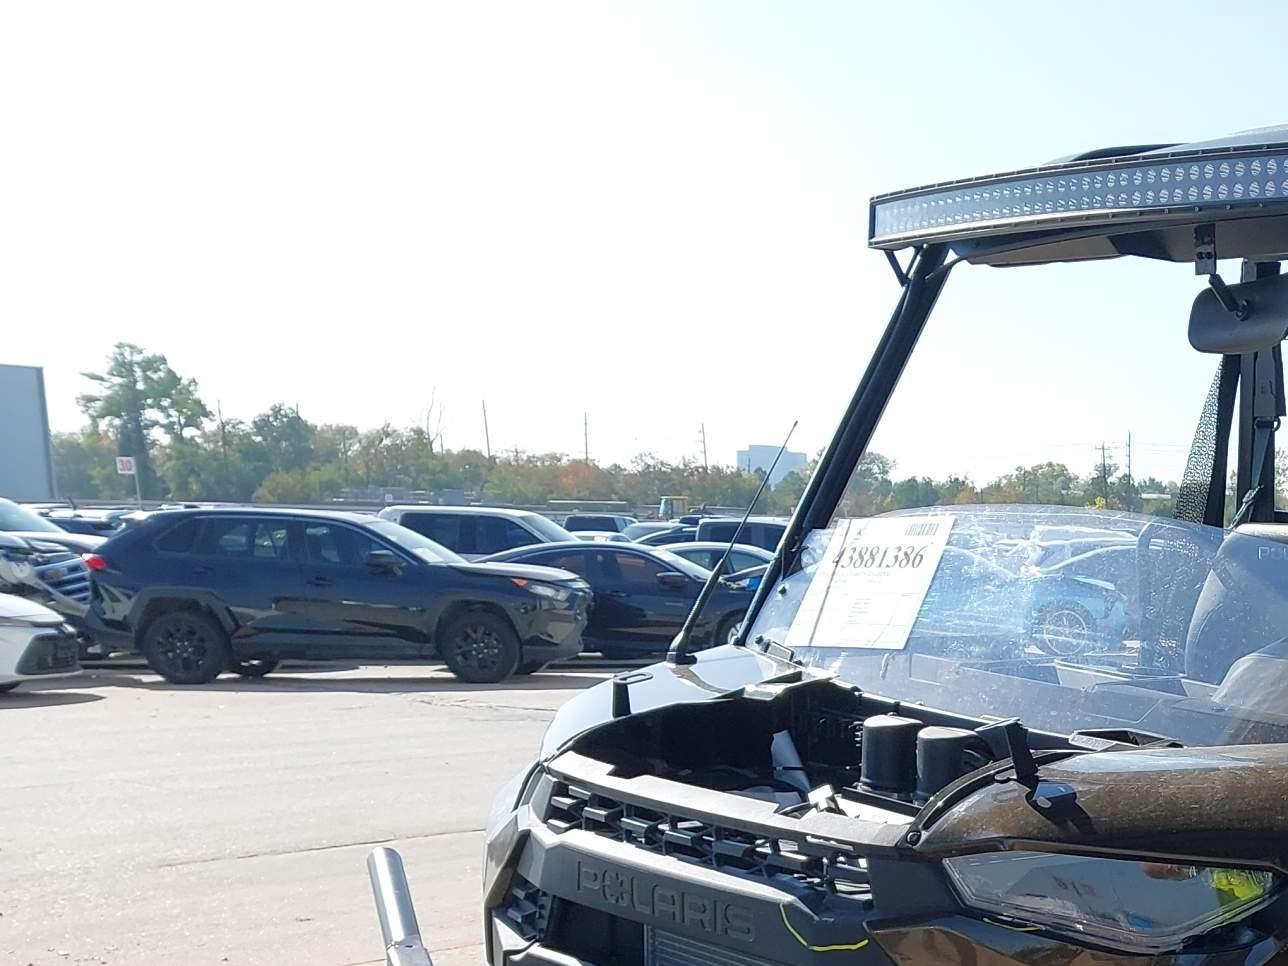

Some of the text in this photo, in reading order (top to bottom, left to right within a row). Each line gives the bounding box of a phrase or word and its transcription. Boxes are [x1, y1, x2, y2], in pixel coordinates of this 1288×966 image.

[118, 458, 134, 473] 30
[831, 543, 930, 570] 43881386
[575, 859, 757, 944] POLARIS
